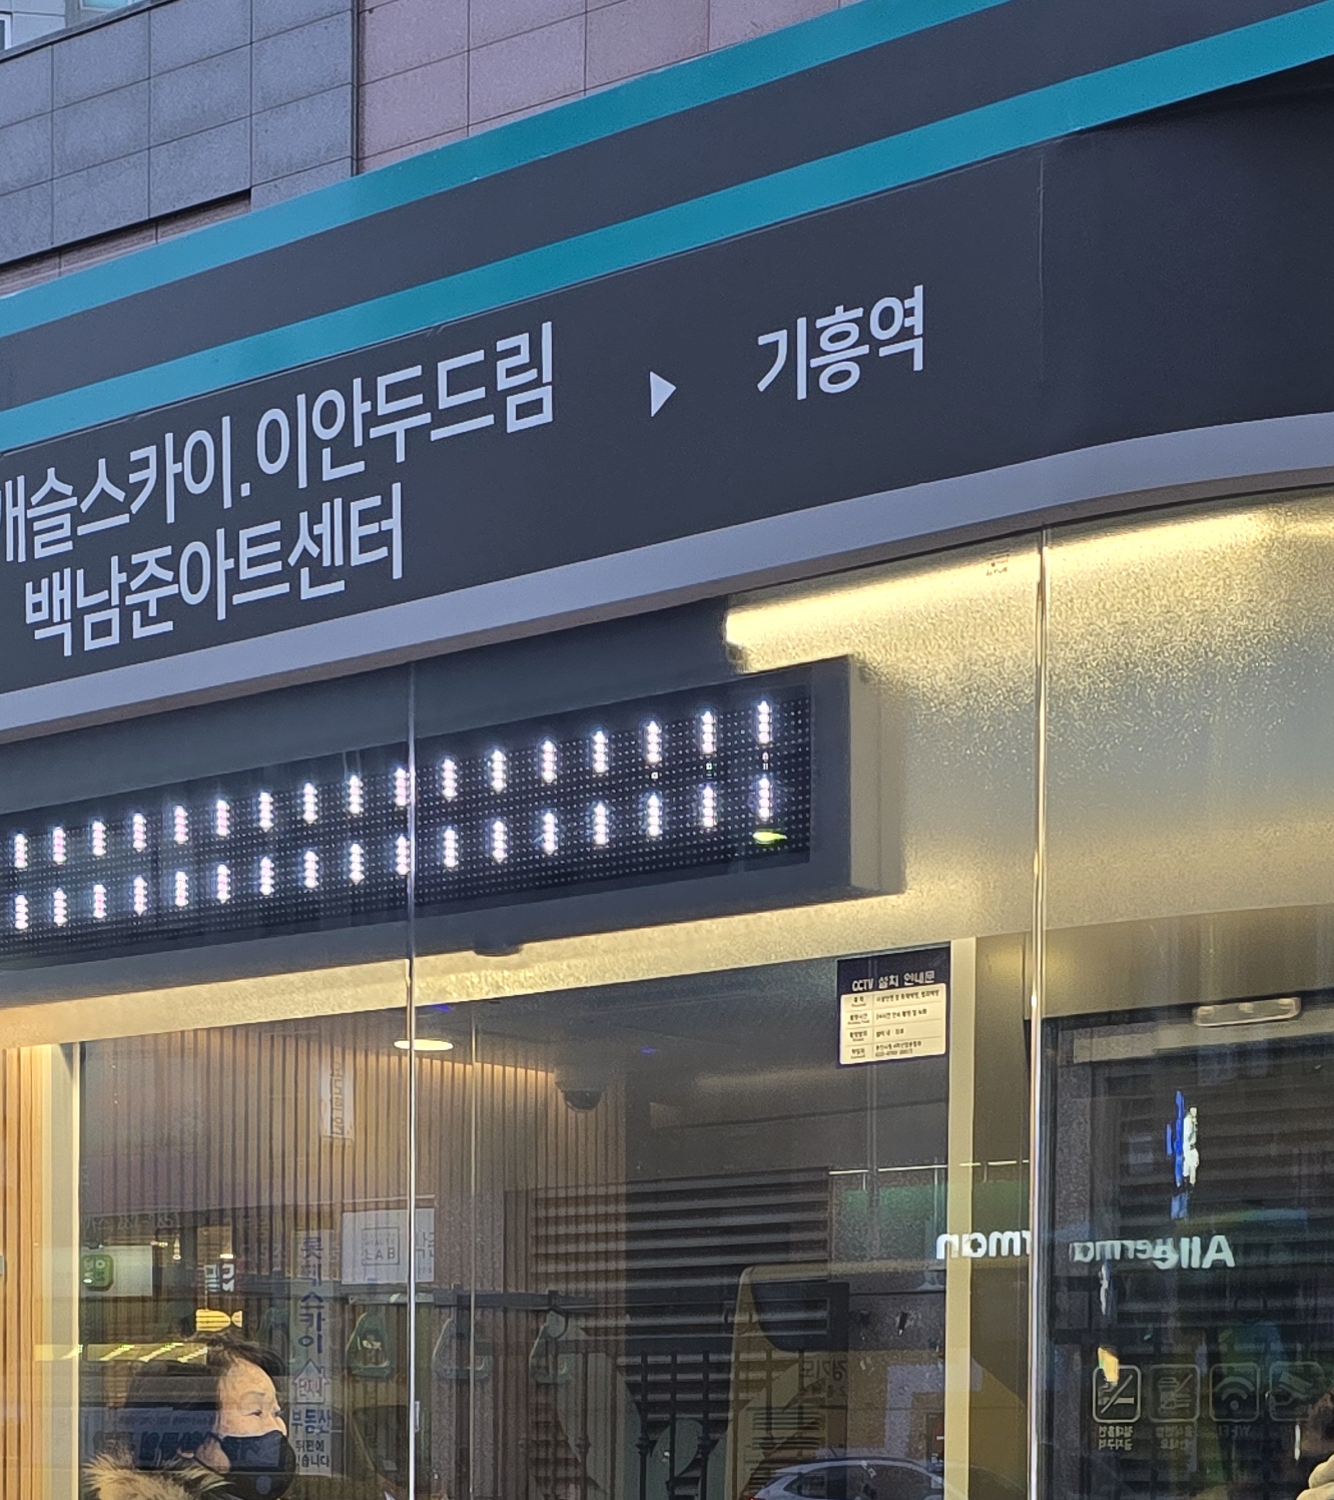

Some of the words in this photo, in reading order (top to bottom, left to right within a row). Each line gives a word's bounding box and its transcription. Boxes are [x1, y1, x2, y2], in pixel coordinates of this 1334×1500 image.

[756, 284, 924, 400] 기흥역
[25, 482, 403, 656] 백남준아트센터
[291, 1408, 331, 1434] 부동산
